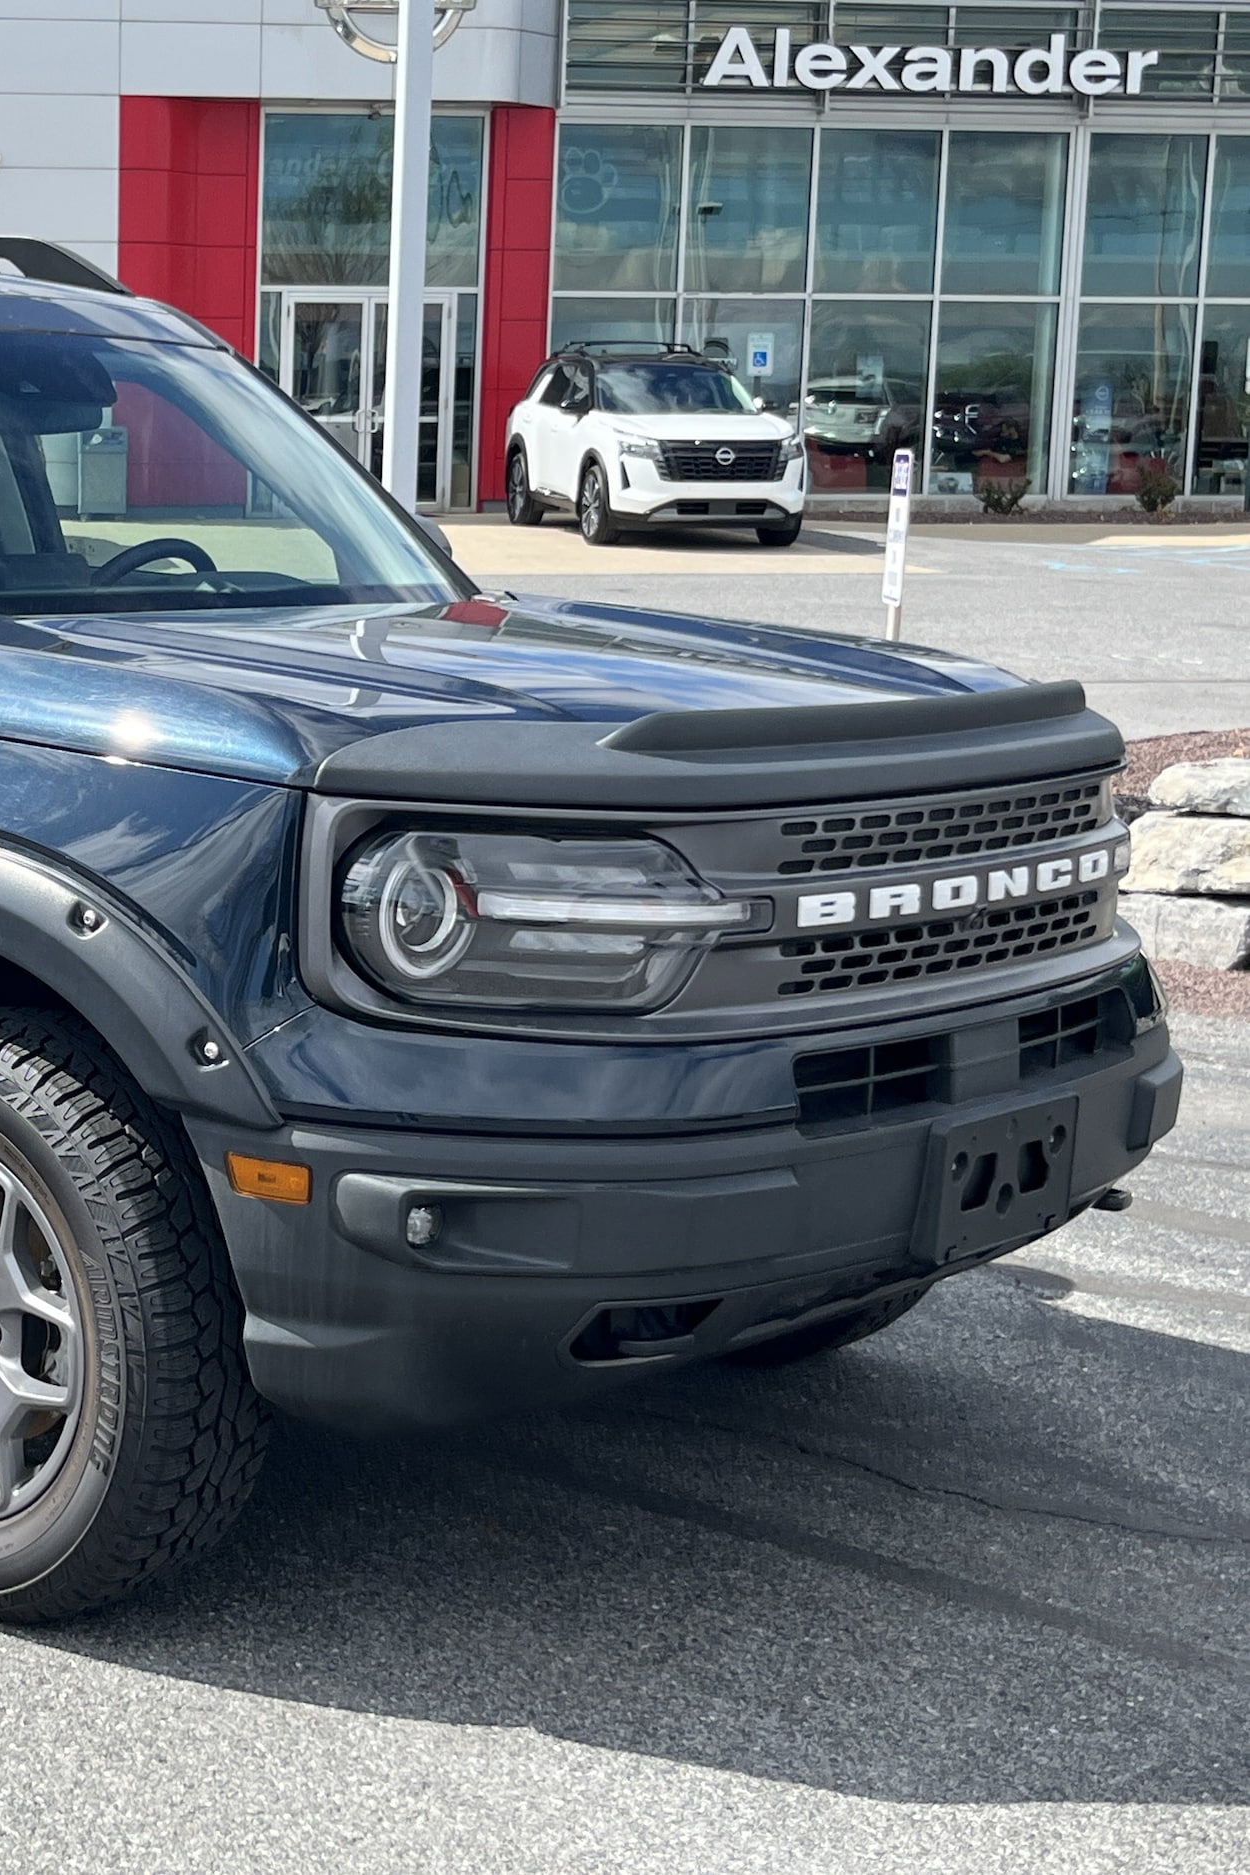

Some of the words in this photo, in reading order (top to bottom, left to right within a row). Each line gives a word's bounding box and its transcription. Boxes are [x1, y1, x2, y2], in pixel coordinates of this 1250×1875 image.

[702, 26, 1159, 95] Alexander
[797, 849, 1110, 928] BRONCO
[80, 1249, 121, 1477] ARMSTRONG
